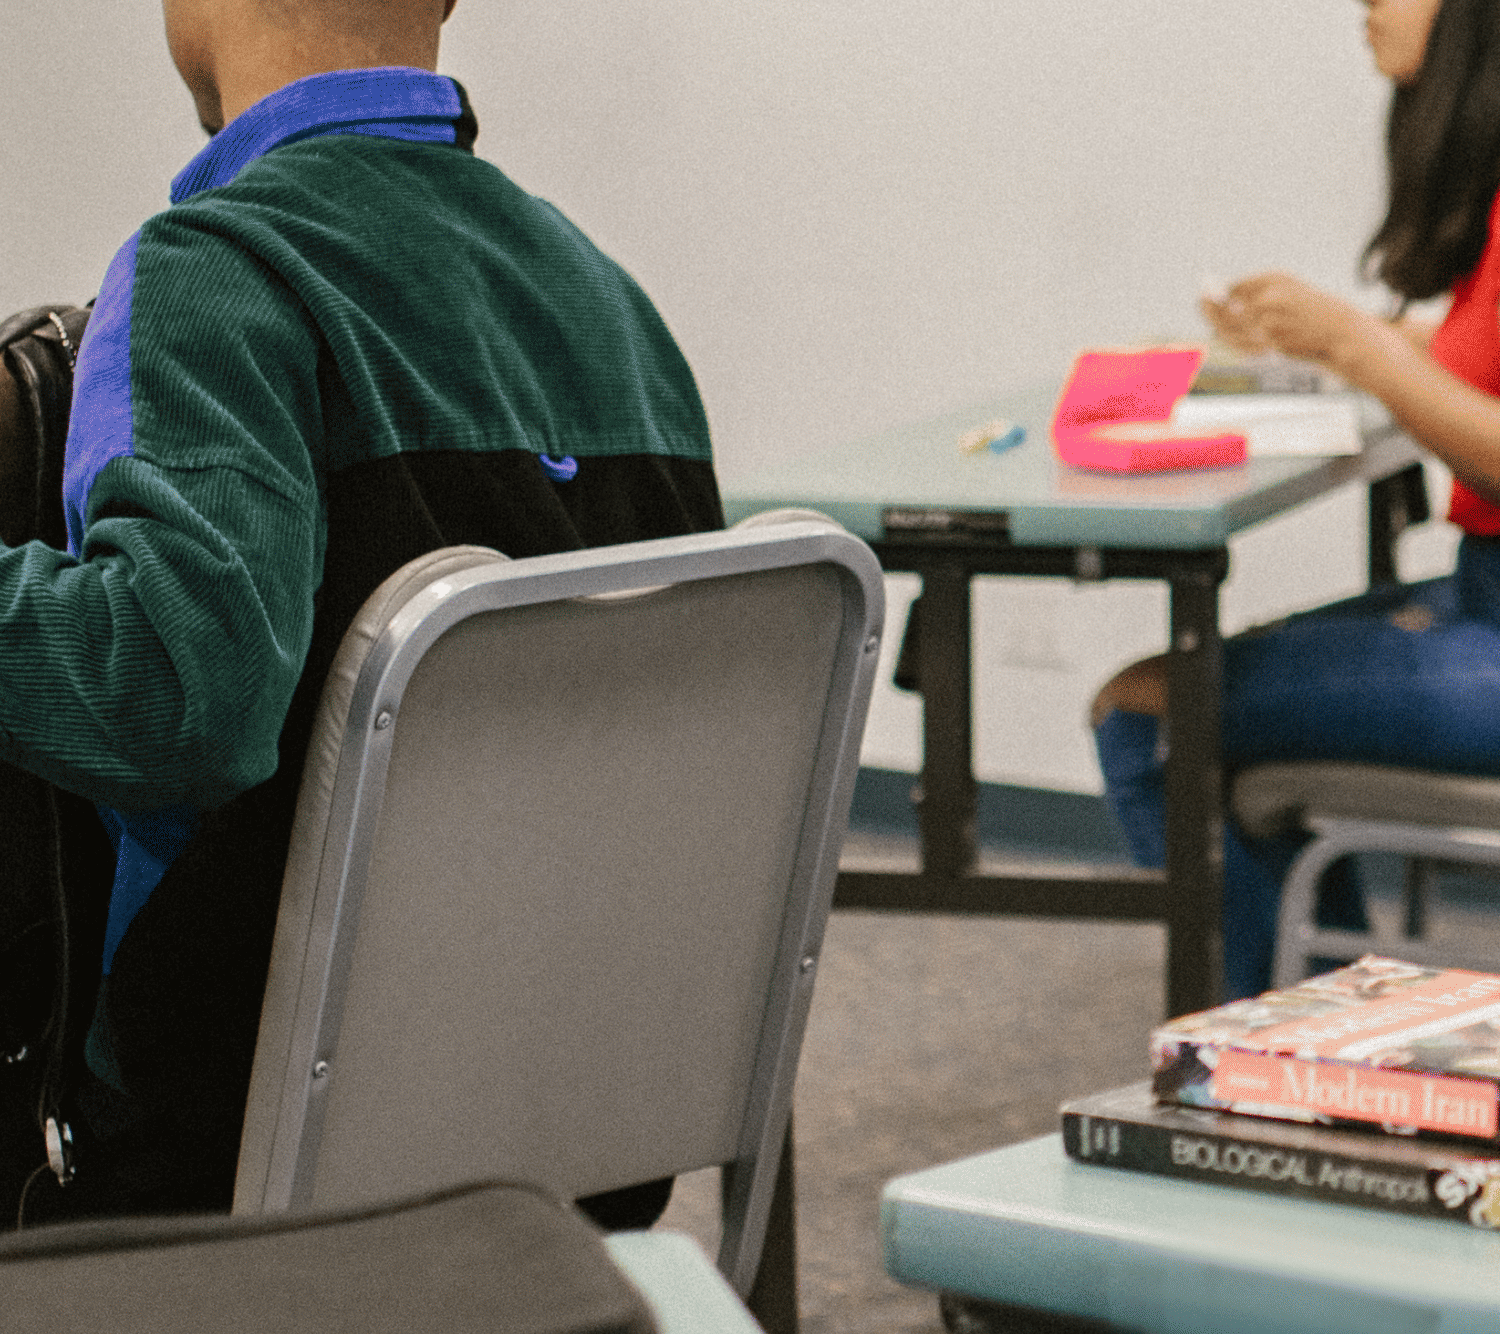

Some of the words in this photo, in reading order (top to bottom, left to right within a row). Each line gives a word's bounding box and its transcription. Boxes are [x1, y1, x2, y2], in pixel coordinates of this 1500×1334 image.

[1282, 1063, 1410, 1118] Modern
[1422, 1080, 1489, 1128] Iran
[1171, 1135, 1312, 1185] BIOLOGICAL
